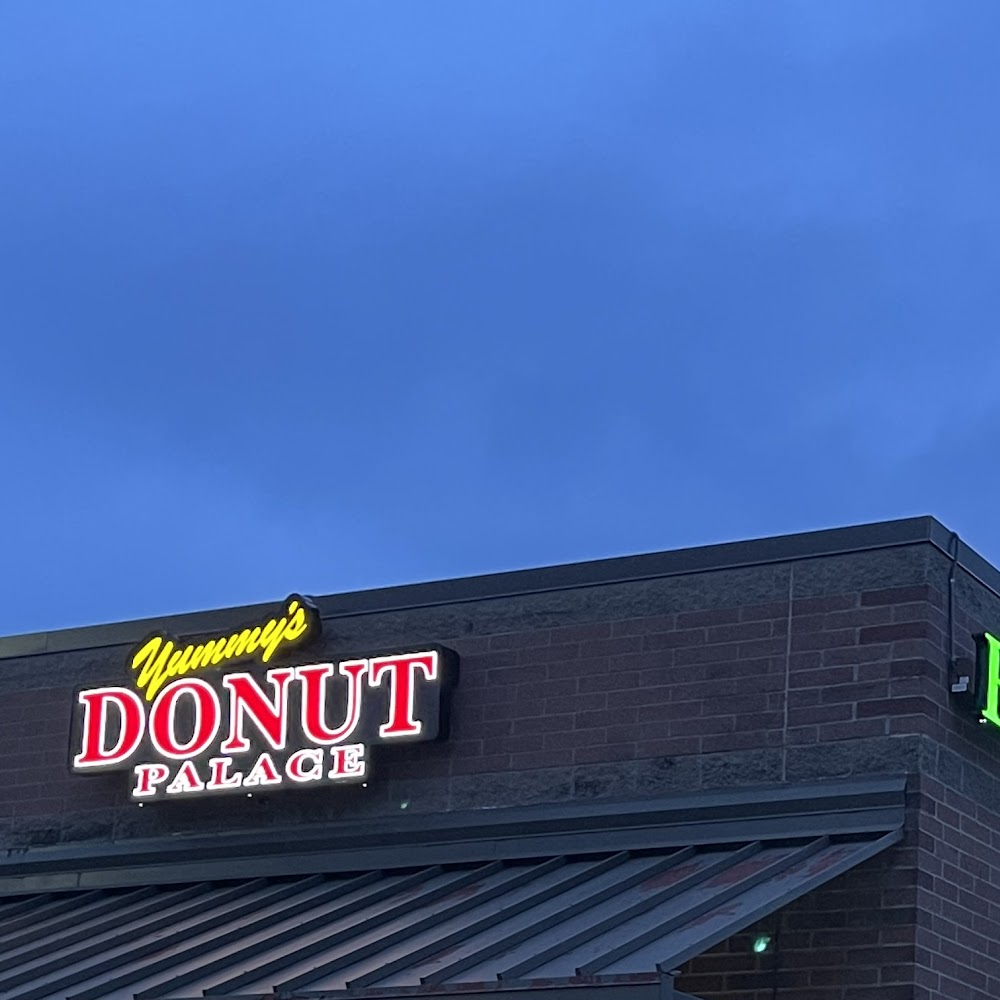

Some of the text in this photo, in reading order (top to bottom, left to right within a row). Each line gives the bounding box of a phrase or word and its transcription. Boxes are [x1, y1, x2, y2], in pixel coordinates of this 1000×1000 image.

[131, 600, 308, 701] Yummy's
[73, 650, 439, 768] DONUT
[132, 743, 367, 798] PALACE
